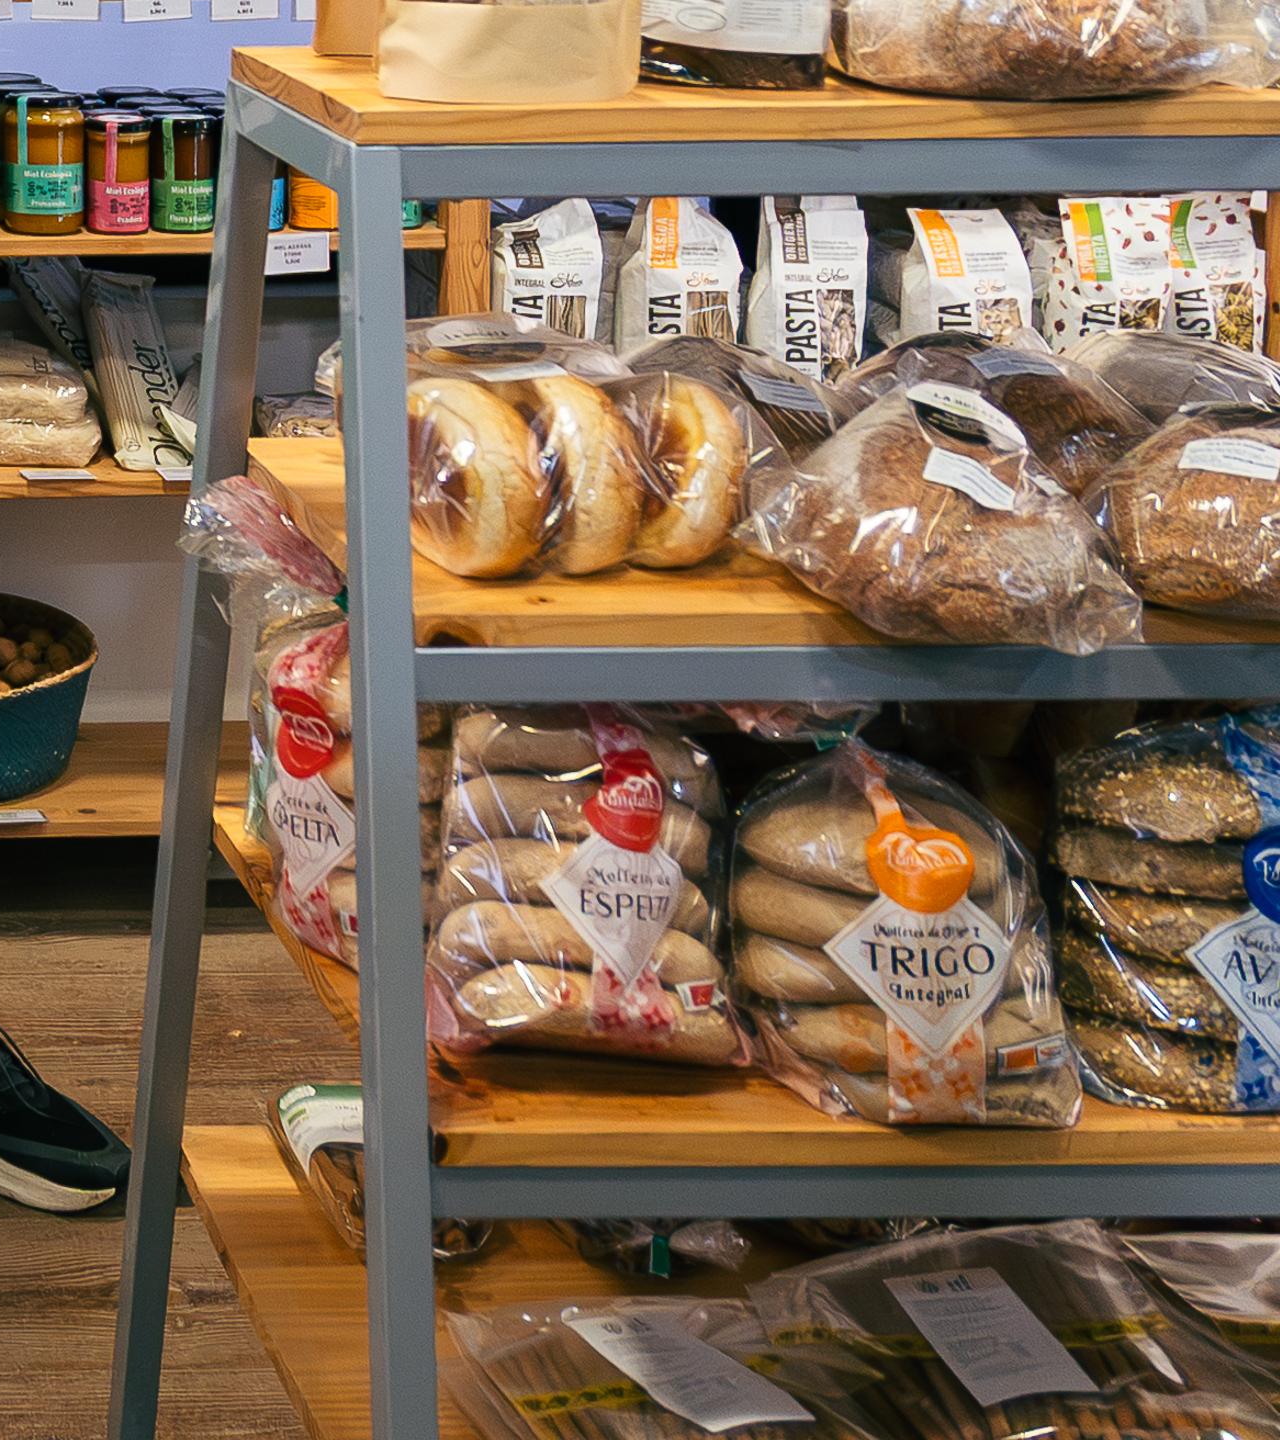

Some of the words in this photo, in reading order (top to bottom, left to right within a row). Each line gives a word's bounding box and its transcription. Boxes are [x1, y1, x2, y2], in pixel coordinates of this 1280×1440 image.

[785, 288, 818, 364] PASTA
[859, 939, 996, 978] TRIGO
[888, 982, 972, 1009] Integral
